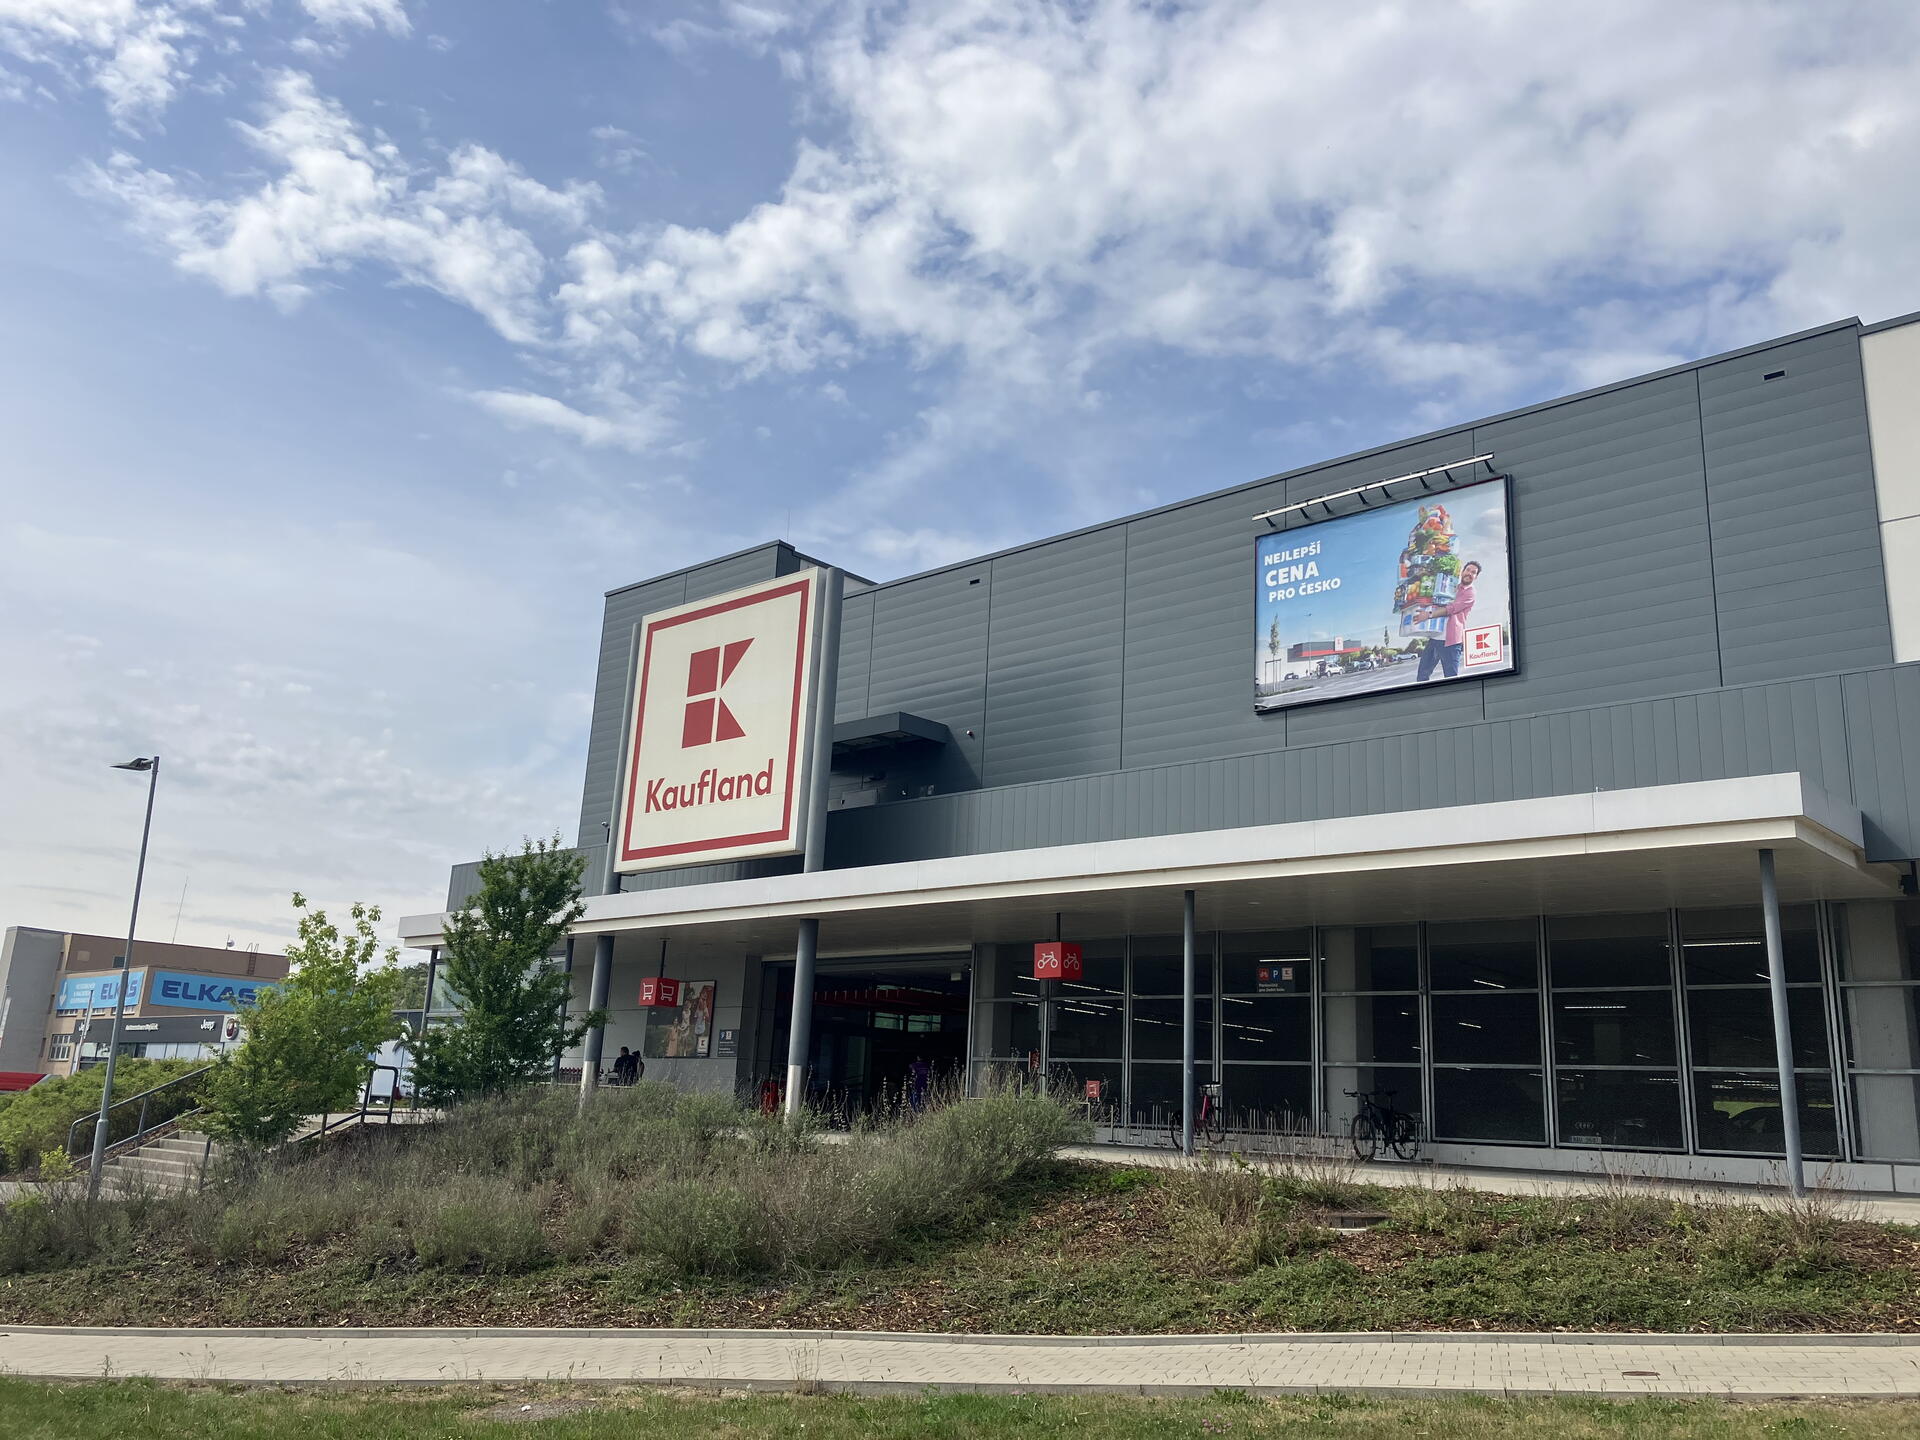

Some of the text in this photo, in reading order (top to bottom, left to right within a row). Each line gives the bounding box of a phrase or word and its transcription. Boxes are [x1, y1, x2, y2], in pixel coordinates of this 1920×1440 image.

[1264, 540, 1321, 566] NEJLEPŠÍ
[1265, 561, 1320, 587] CENA
[1269, 577, 1342, 603] PRO ČESKO
[1469, 650, 1499, 660] Kaufland
[682, 637, 755, 749] K
[645, 758, 774, 814] Kaufland
[100, 979, 138, 1000] ELKS
[200, 1019, 215, 1031] Jeep
